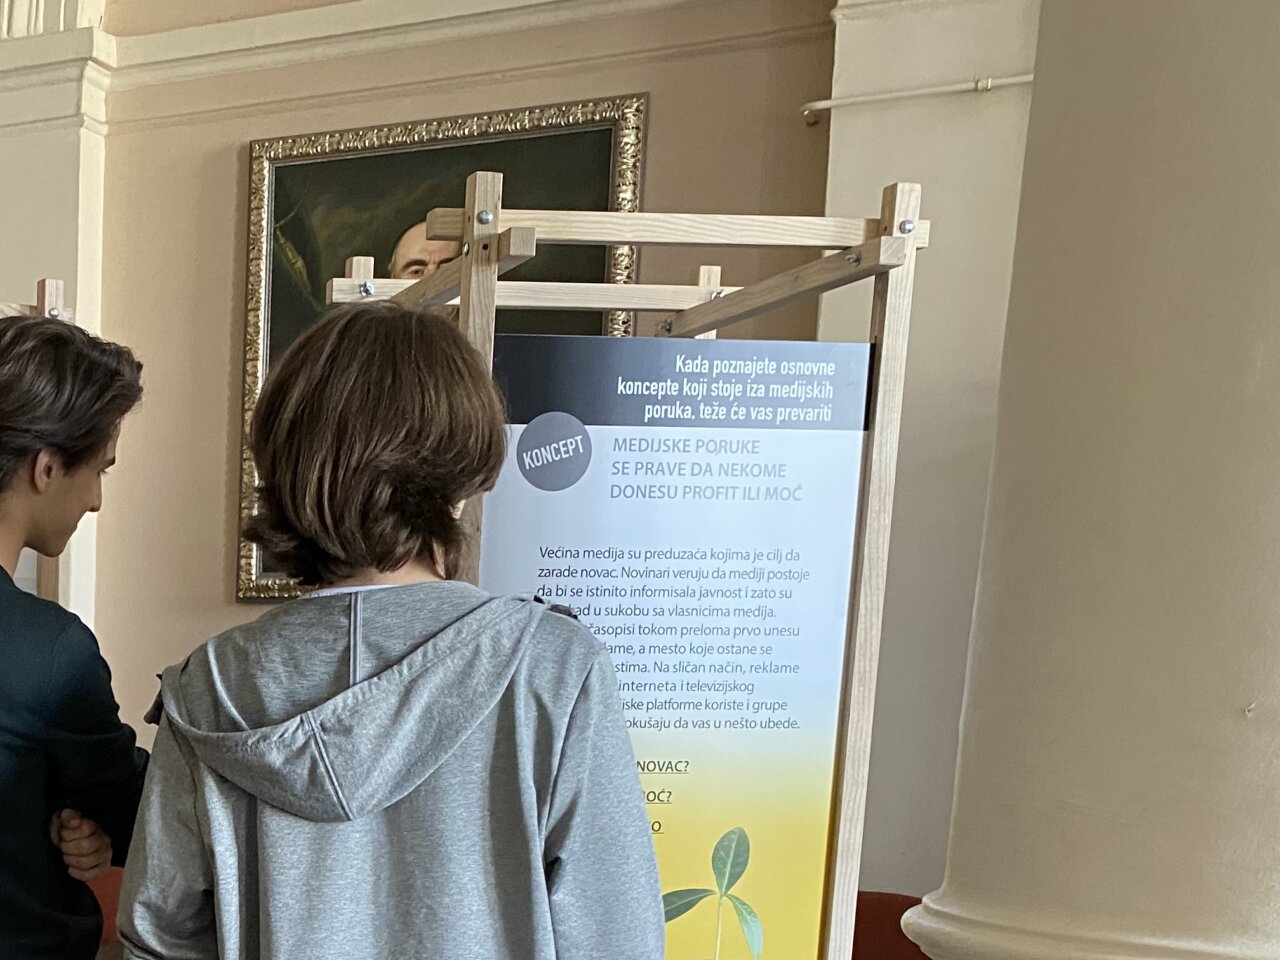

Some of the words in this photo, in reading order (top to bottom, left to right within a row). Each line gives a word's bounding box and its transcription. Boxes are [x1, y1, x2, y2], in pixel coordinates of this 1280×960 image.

[676, 354, 709, 373] Kada
[713, 356, 777, 378] poznajete
[780, 361, 836, 376] osnovne
[617, 376, 679, 400] koncepte
[683, 378, 707, 400] koji
[711, 379, 742, 401] stoje
[746, 379, 765, 397] iza
[769, 379, 834, 402] medijskih
[644, 401, 696, 422] poruka,
[699, 402, 726, 420] teže
[730, 402, 746, 420] će
[750, 407, 773, 421] vas
[776, 404, 832, 424] prevariti
[522, 435, 584, 470] KONCEPT
[613, 438, 691, 454] MEDIJSKE
[695, 438, 761, 455] PORUKE
[611, 461, 631, 476] SE
[634, 462, 687, 477] PRAVE
[691, 462, 714, 477] DA
[717, 463, 787, 478] NEKOME
[610, 484, 677, 499] DONESU
[682, 485, 739, 501] PROFIT
[742, 486, 761, 501] ILI
[539, 546, 580, 559] Većina
[582, 547, 625, 562] medija
[627, 550, 641, 560] su
[644, 547, 707, 562] preduzaća
[710, 547, 750, 564] kojima
[751, 548, 764, 564] je
[766, 548, 783, 564] cilj
[785, 548, 800, 561] da
[537, 565, 578, 578] zarade
[621, 566, 671, 579] Novinari
[672, 567, 709, 582] veruju
[711, 567, 726, 580] da
[767, 568, 810, 583] postoje
[536, 584, 552, 597] da
[555, 584, 567, 597] bi
[570, 587, 583, 597] se
[586, 584, 627, 597] istinito
[630, 585, 696, 598] informisala
[697, 585, 743, 601] javnost
[744, 586, 749, 599] i
[750, 588, 776, 599] zato
[778, 589, 793, 599] su
[593, 606, 601, 616] u
[604, 604, 649, 616] sukobu
[652, 607, 665, 616] sa
[668, 604, 730, 617] vlasnicima
[733, 605, 777, 621] medija.
[638, 623, 677, 635] tokom
[680, 623, 730, 638] preloma
[733, 627, 761, 639] prvo
[763, 627, 800, 636] unesu
[638, 645, 646, 654] a
[648, 643, 687, 654] mesto
[689, 642, 715, 658] koje
[717, 644, 757, 655] ostane
[760, 645, 773, 655] se
[614, 661, 650, 673] stima.
[653, 661, 669, 673] Na
[672, 660, 706, 673] sličan
[708, 661, 746, 675] način,
[749, 660, 800, 674] reklame
[618, 680, 677, 692] interneta
[686, 680, 755, 695] televizijskog
[646, 697, 702, 713] platforme
[704, 698, 744, 711] koriste
[752, 701, 788, 714] grupe
[626, 716, 671, 732] okušaju
[673, 716, 689, 729] da
[692, 719, 711, 729] vas
[713, 719, 721, 729] u
[724, 716, 757, 729] nešto
[760, 716, 800, 729] ubede.
[636, 760, 690, 773] NOVAC?
